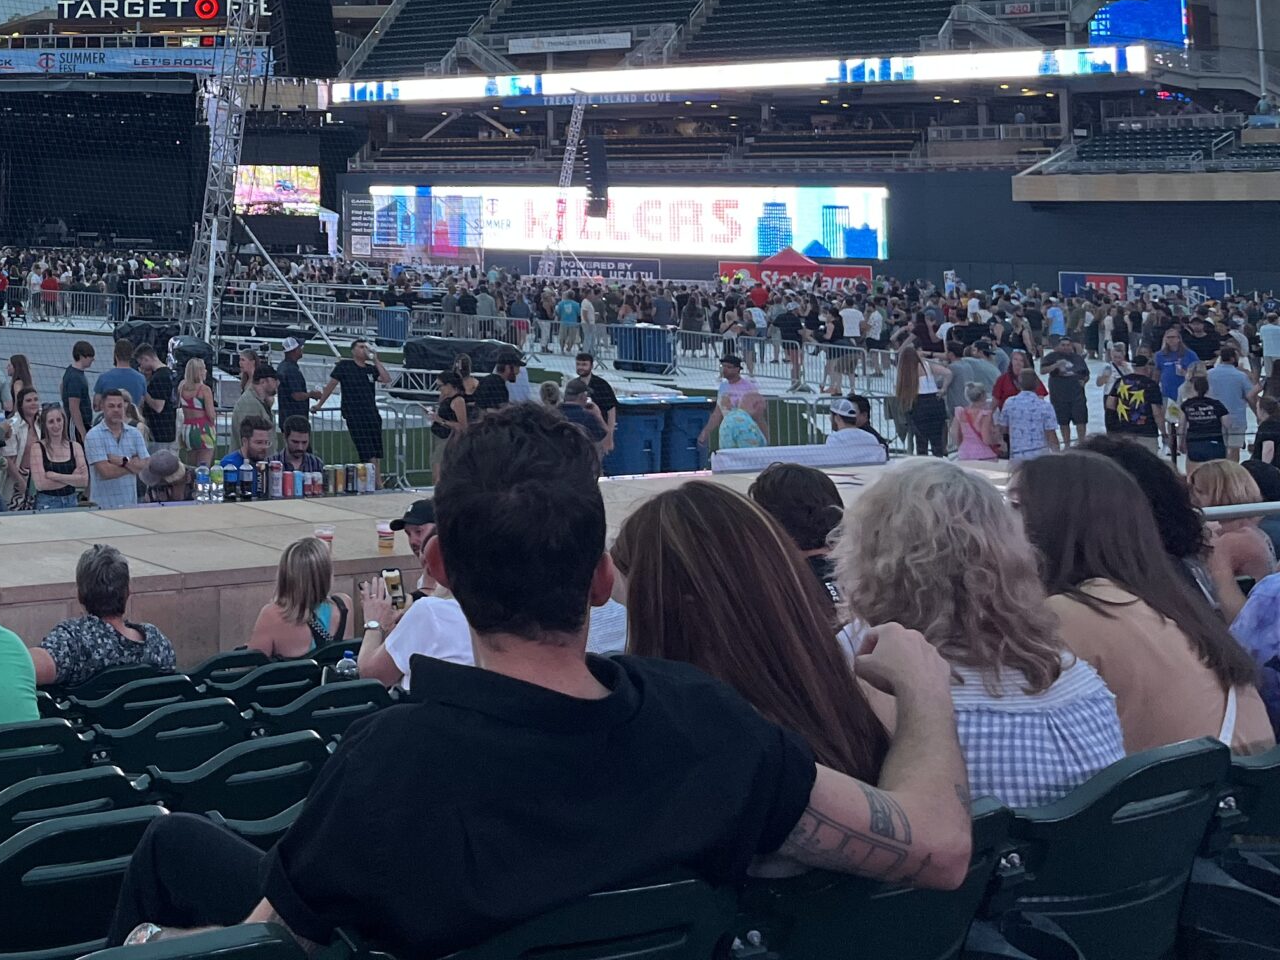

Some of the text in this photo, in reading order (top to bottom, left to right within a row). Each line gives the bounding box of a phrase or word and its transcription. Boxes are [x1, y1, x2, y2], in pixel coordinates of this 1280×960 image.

[59, 52, 106, 65] SUMMER
[133, 57, 212, 66] LET'S ROCK
[58, 64, 77, 73] FEST
[542, 92, 671, 105] TREASURE ISLAND COVE
[560, 260, 633, 270] POWERED BY
